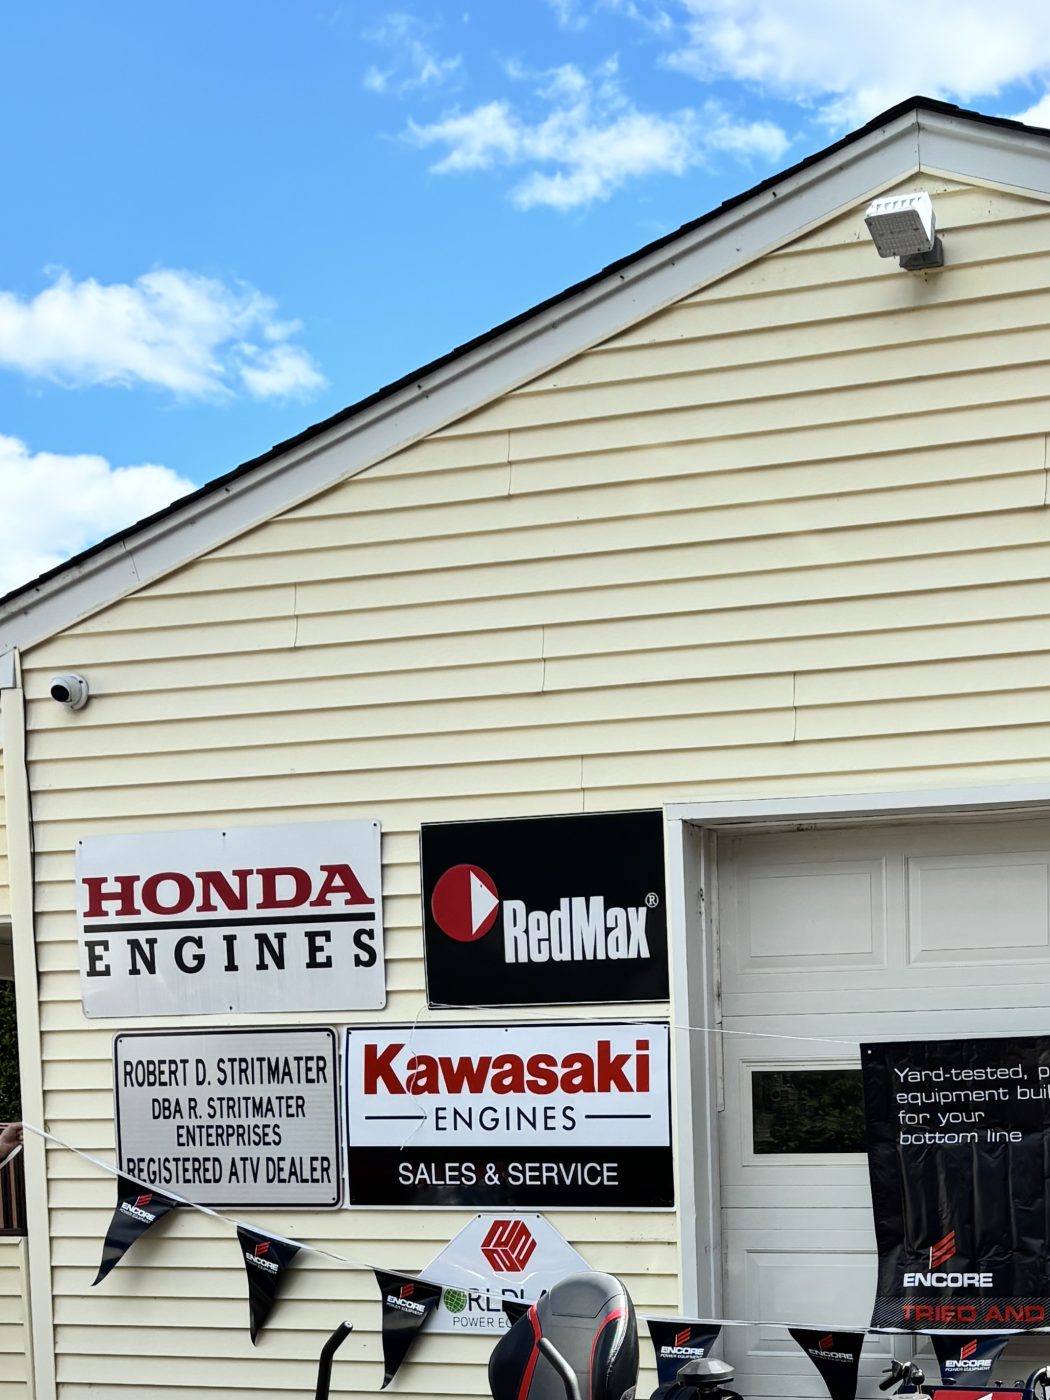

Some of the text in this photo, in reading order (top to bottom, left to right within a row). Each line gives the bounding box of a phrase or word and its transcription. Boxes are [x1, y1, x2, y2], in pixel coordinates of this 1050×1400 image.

[82, 864, 375, 918] HONDA
[84, 928, 377, 977] ENGINES
[123, 1055, 328, 1087] ROBERT D. STRITMATER
[364, 1039, 650, 1095] Kawasaki
[894, 1064, 1028, 1083] Yard-tested,
[896, 1087, 1009, 1106] equipment
[152, 1095, 306, 1120] DBA R. STRITMATER
[435, 1105, 576, 1131] ENGINES
[898, 1110, 985, 1127] for your
[176, 1123, 282, 1147] ENTERPRISES
[900, 1129, 1022, 1145] bottom line
[127, 1156, 331, 1184] REGISTERED ATV DEALER
[398, 1162, 619, 1186] SALES & SERVICE
[121, 1202, 156, 1221] ENCORE
[245, 1252, 279, 1271] ENCORE
[903, 1272, 993, 1287] ENCORE
[387, 1295, 425, 1312] ENCORE
[902, 1304, 976, 1322] TRIED
[984, 1304, 1045, 1322] AND
[453, 1316, 494, 1328] POWER
[661, 1346, 704, 1355] ENCORE
[808, 1349, 853, 1360] ENCORE
